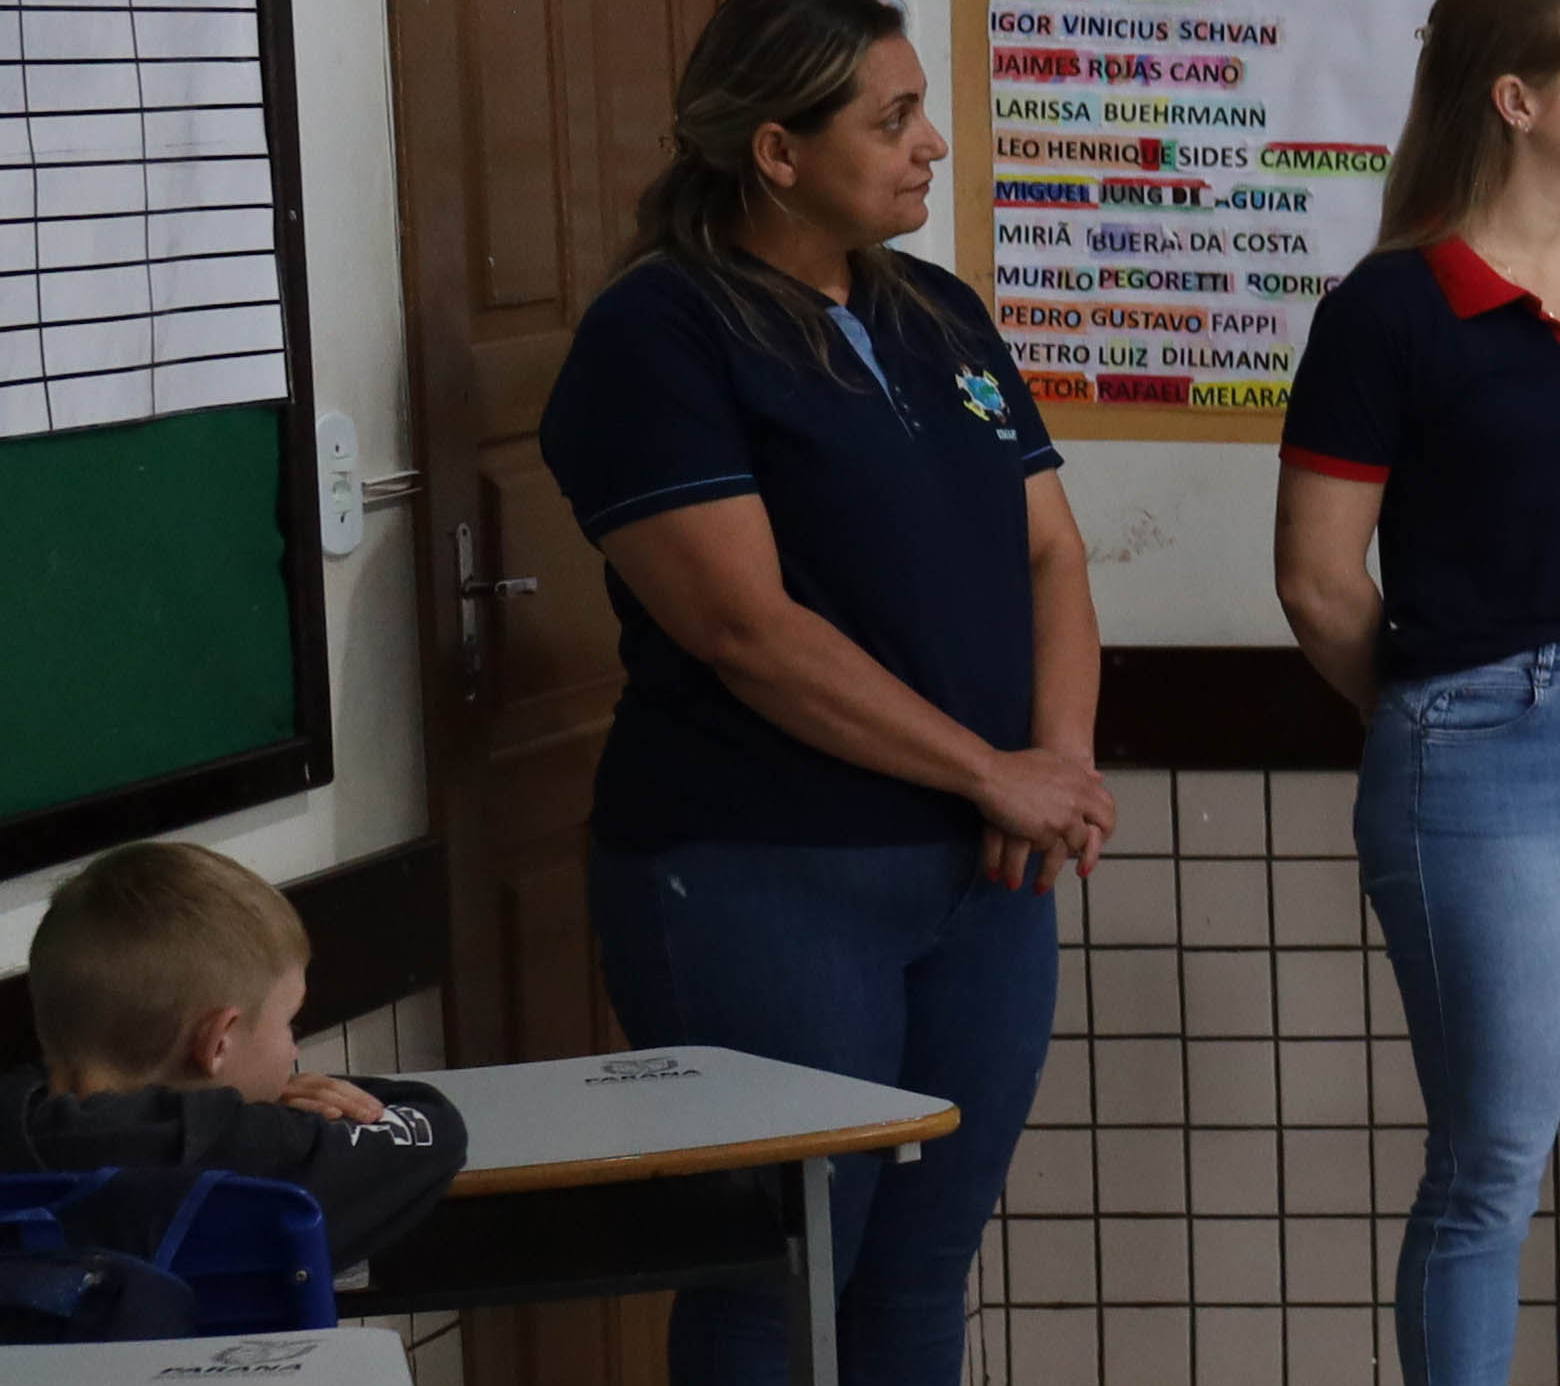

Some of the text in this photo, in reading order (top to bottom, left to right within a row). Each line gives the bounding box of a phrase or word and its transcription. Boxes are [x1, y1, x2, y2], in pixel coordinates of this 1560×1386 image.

[990, 12, 1278, 46] IGOR VINICIUS SCHVAN
[993, 50, 1239, 85] JAIMES ROJAS CANO
[995, 99, 1267, 128] LARISSA BUEHRMANN
[997, 137, 1387, 173] LEO HENRIQUE SIDES CAMARGO
[999, 222, 1308, 254] MIRIÃ DA COSTA
[997, 265, 1229, 293] MURILO PEGORETTI
[1000, 305, 1277, 334] PEDRO GUSTAVO FAPPI
[1099, 344, 1289, 371] LUIZ DILLMANN
[1097, 378, 1186, 402] RAFAEL
